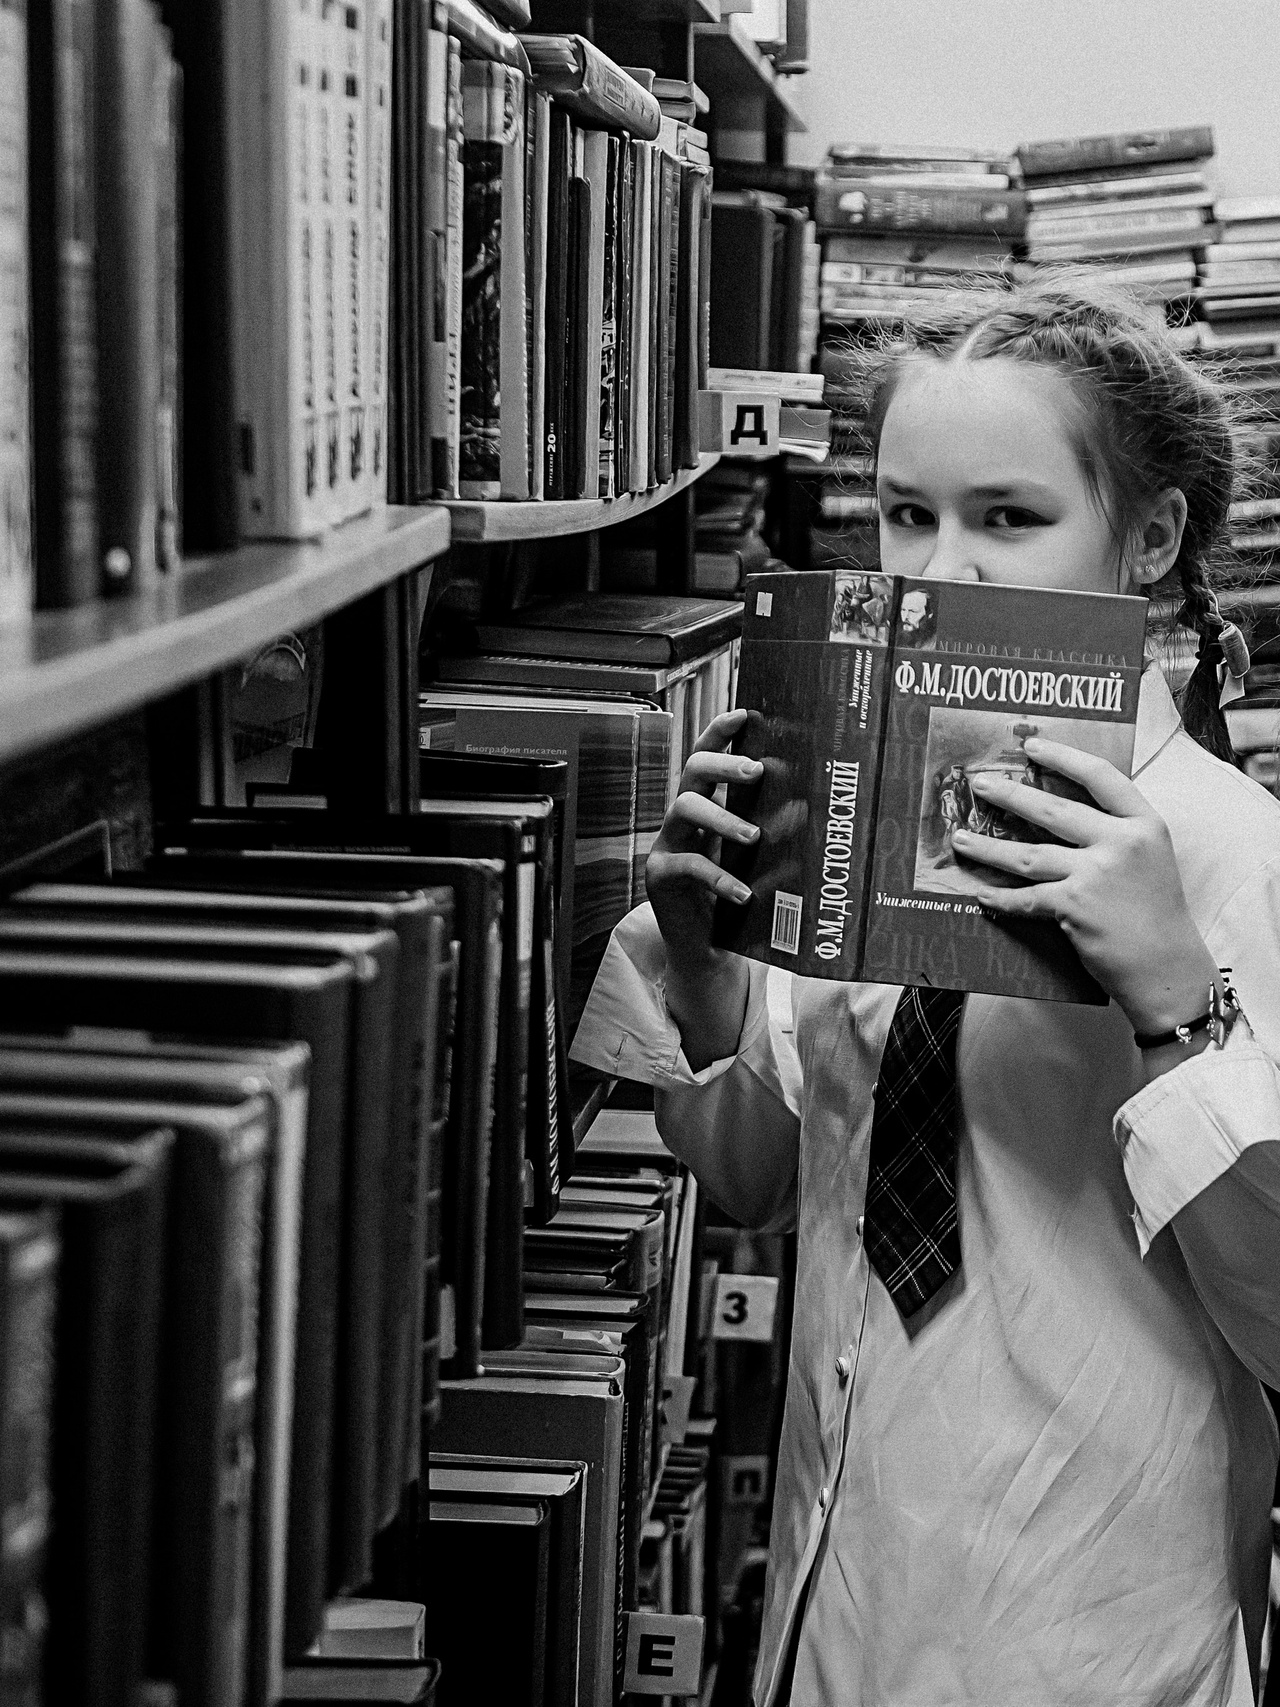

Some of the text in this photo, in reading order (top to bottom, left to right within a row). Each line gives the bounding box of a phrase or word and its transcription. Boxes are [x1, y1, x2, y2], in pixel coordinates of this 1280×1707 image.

[546, 433, 557, 453] 20
[730, 405, 768, 445] Д
[938, 640, 1128, 667] МИРОВАЯ КЛАССИКА
[848, 648, 864, 709] Униженные
[859, 649, 874, 721] оскорбленные
[894, 660, 1125, 713] Ф.М.ДОСТОЕВСКИЙ
[465, 743, 569, 757] Биография писателя
[814, 759, 861, 961] Ф.М.ДОСТОЕВСКИЙ
[875, 891, 952, 912] Униженные
[953, 902, 963, 914] и
[544, 999, 559, 1154] ДОСТОЕВСКИЙ
[638, 1634, 676, 1677] Е
